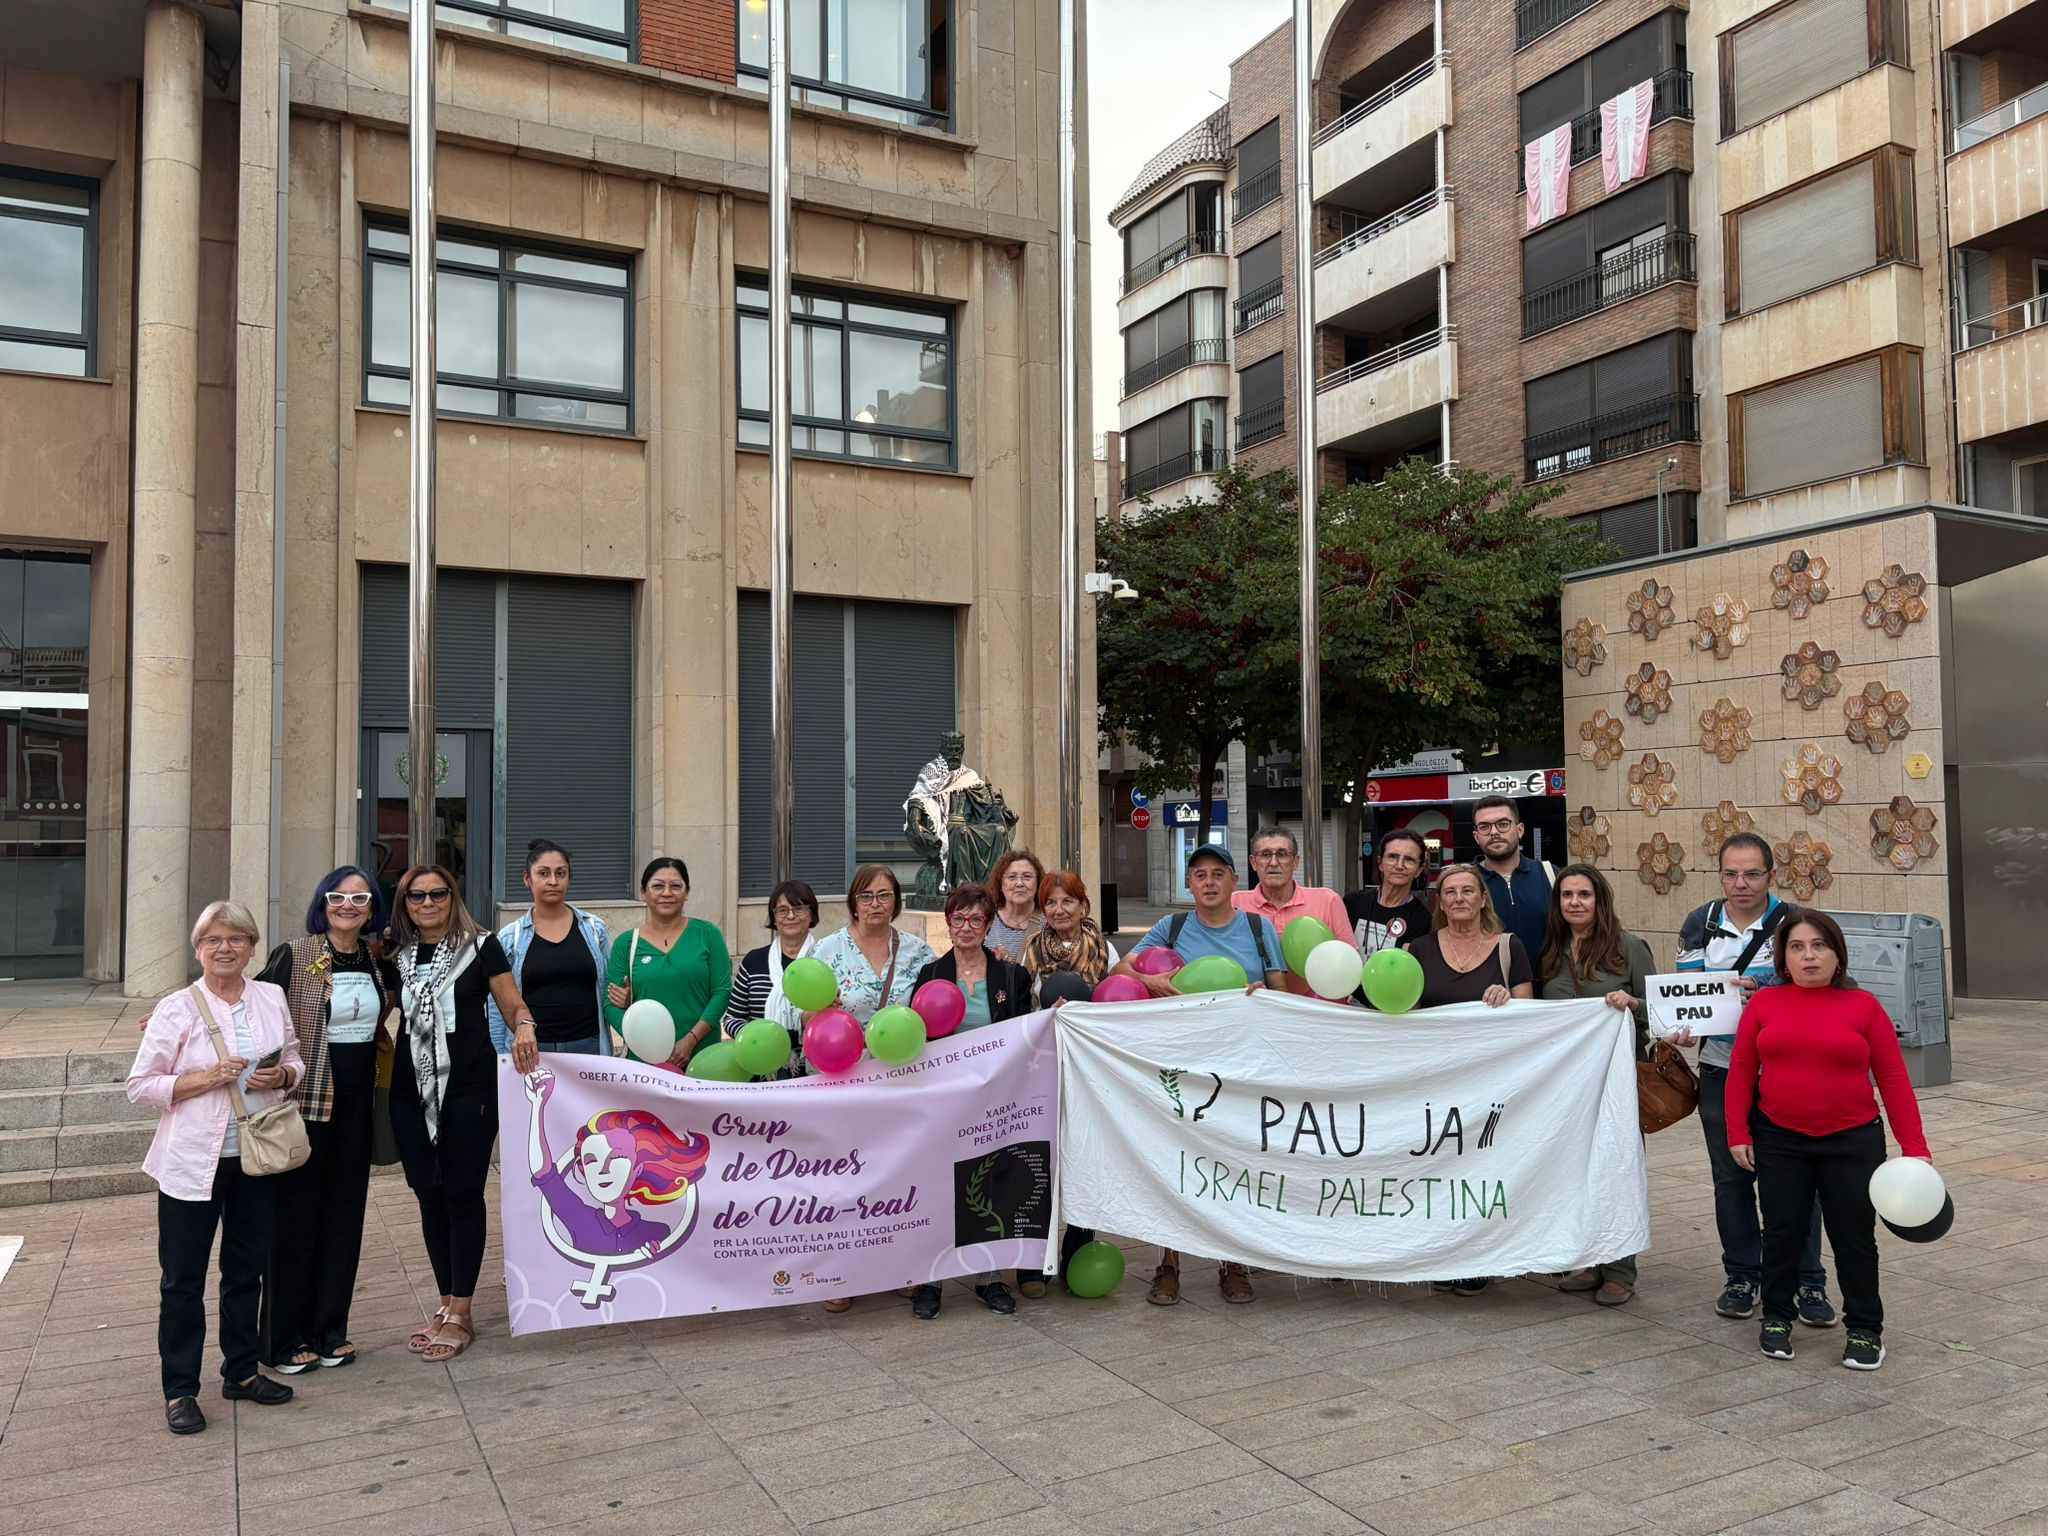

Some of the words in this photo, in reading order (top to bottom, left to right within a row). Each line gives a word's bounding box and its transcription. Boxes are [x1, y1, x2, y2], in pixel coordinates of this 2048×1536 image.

[1468, 776, 1517, 793] iberCaja
[1659, 982, 1725, 998] VOLEM
[1676, 1006, 1713, 1021] PAU
[579, 1071, 617, 1083] OBERT
[620, 1073, 629, 1083] A
[632, 1073, 671, 1089] TOTES
[849, 1077, 865, 1085] EN
[868, 1073, 883, 1083] LA
[886, 1056, 942, 1079] IGUALTAT
[945, 1053, 961, 1064] DE
[963, 1038, 1006, 1058] GÈNERE
[958, 1121, 994, 1138] DONES
[996, 1115, 1009, 1128] DE
[1011, 1106, 1045, 1121] NEGRE
[985, 1101, 1018, 1119] XARXA
[711, 1112, 792, 1144] Grup
[974, 1133, 993, 1146] PER
[995, 1128, 1007, 1140] LA
[1009, 1121, 1030, 1134] PAU
[1260, 1095, 1365, 1158] PAU
[721, 1151, 764, 1183] de
[765, 1147, 867, 1181] Dones
[1179, 1150, 1288, 1214] ISRAEL
[1316, 1176, 1509, 1220] PALESTINA
[712, 1200, 755, 1230] de
[754, 1184, 919, 1228] Vila-real
[713, 1238, 733, 1249] PER
[735, 1238, 749, 1247] LA
[752, 1234, 808, 1246] IGUALTAT,
[811, 1232, 824, 1242] LA
[827, 1230, 848, 1241] PAU
[857, 1217, 932, 1238] L'ECOLOGISME
[714, 1249, 759, 1260] CONTRA
[761, 1247, 775, 1257] LA
[838, 1240, 852, 1251] DE
[854, 1235, 895, 1249] GÈNERE
